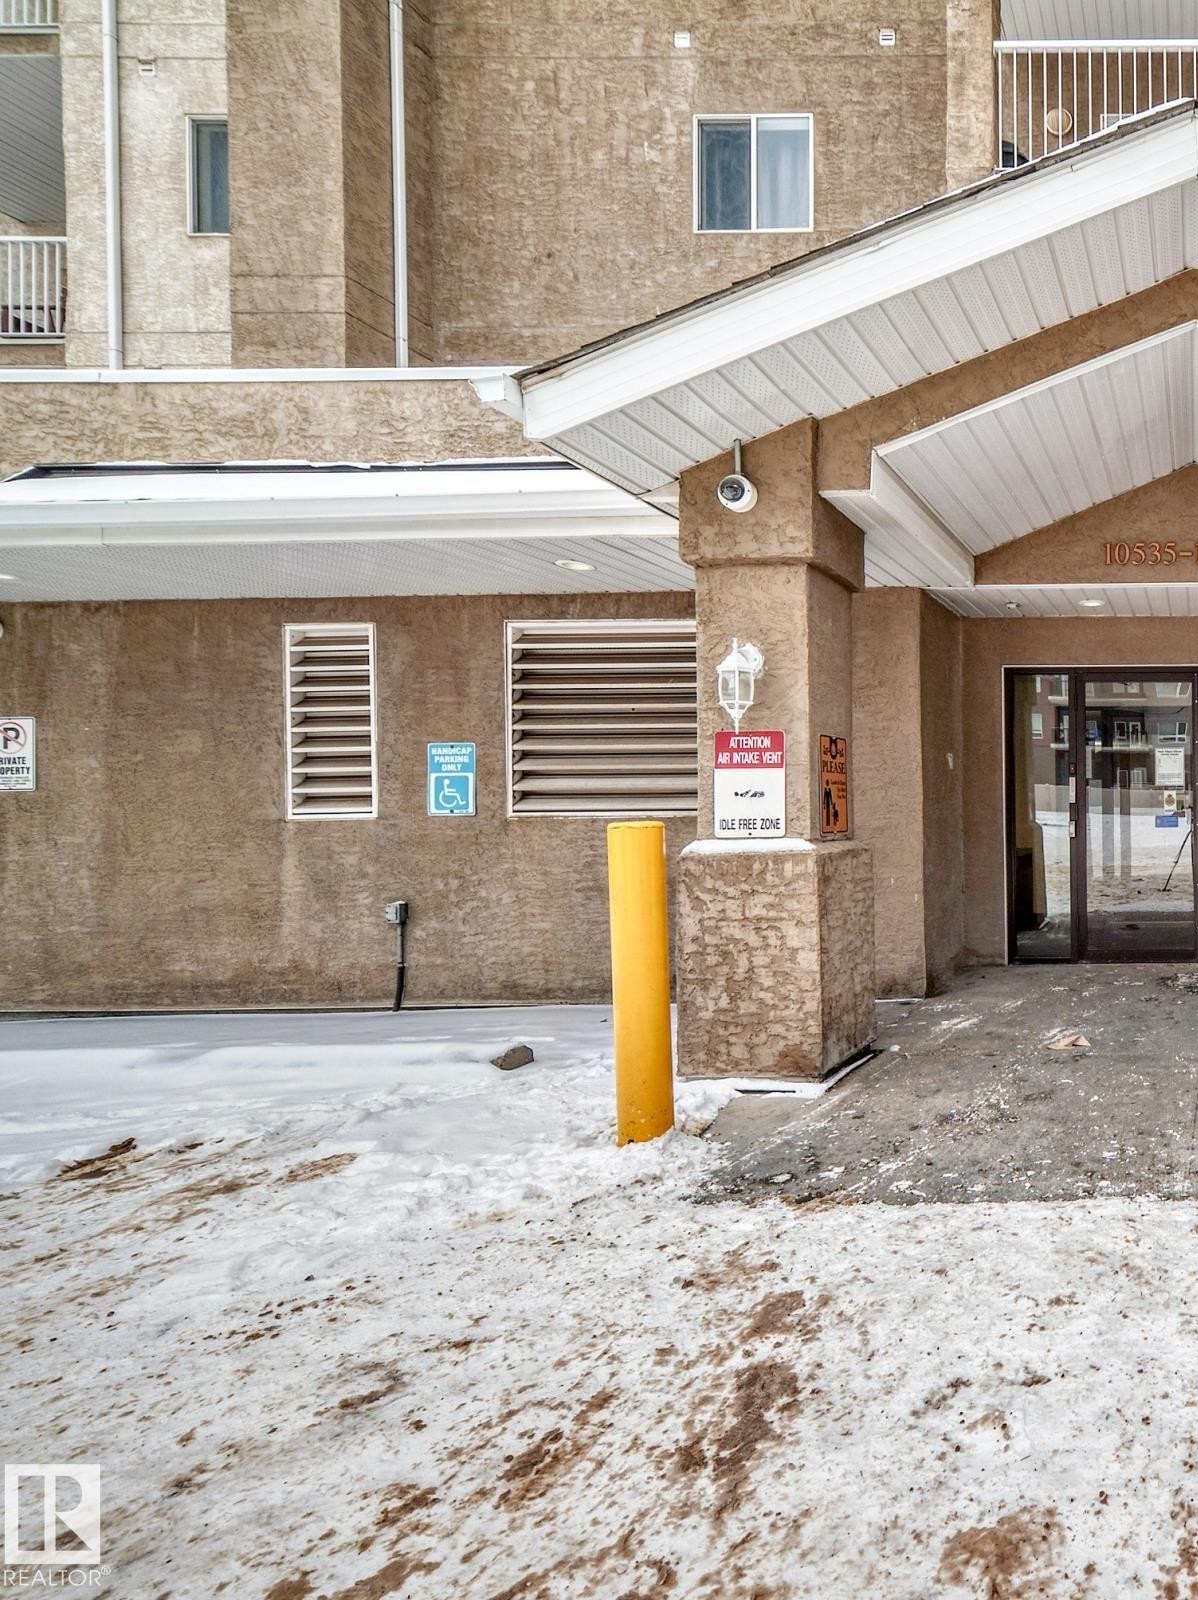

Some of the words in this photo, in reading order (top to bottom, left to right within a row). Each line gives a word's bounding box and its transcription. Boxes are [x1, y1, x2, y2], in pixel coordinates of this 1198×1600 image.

[729, 736, 771, 749] ATTENTION
[431, 747, 472, 755] HANDICAP
[0, 757, 26, 765] RIVATE
[434, 755, 470, 763] PARKING
[717, 752, 730, 764] AIR
[732, 752, 759, 764] INTAKE
[762, 752, 782, 763] VENT
[0, 767, 31, 775] OPERTY
[441, 763, 462, 771] ONLY
[822, 760, 847, 774] PLEASE
[719, 818, 735, 830] IDLE
[738, 818, 757, 830] FREE
[760, 818, 781, 830] ZONE
